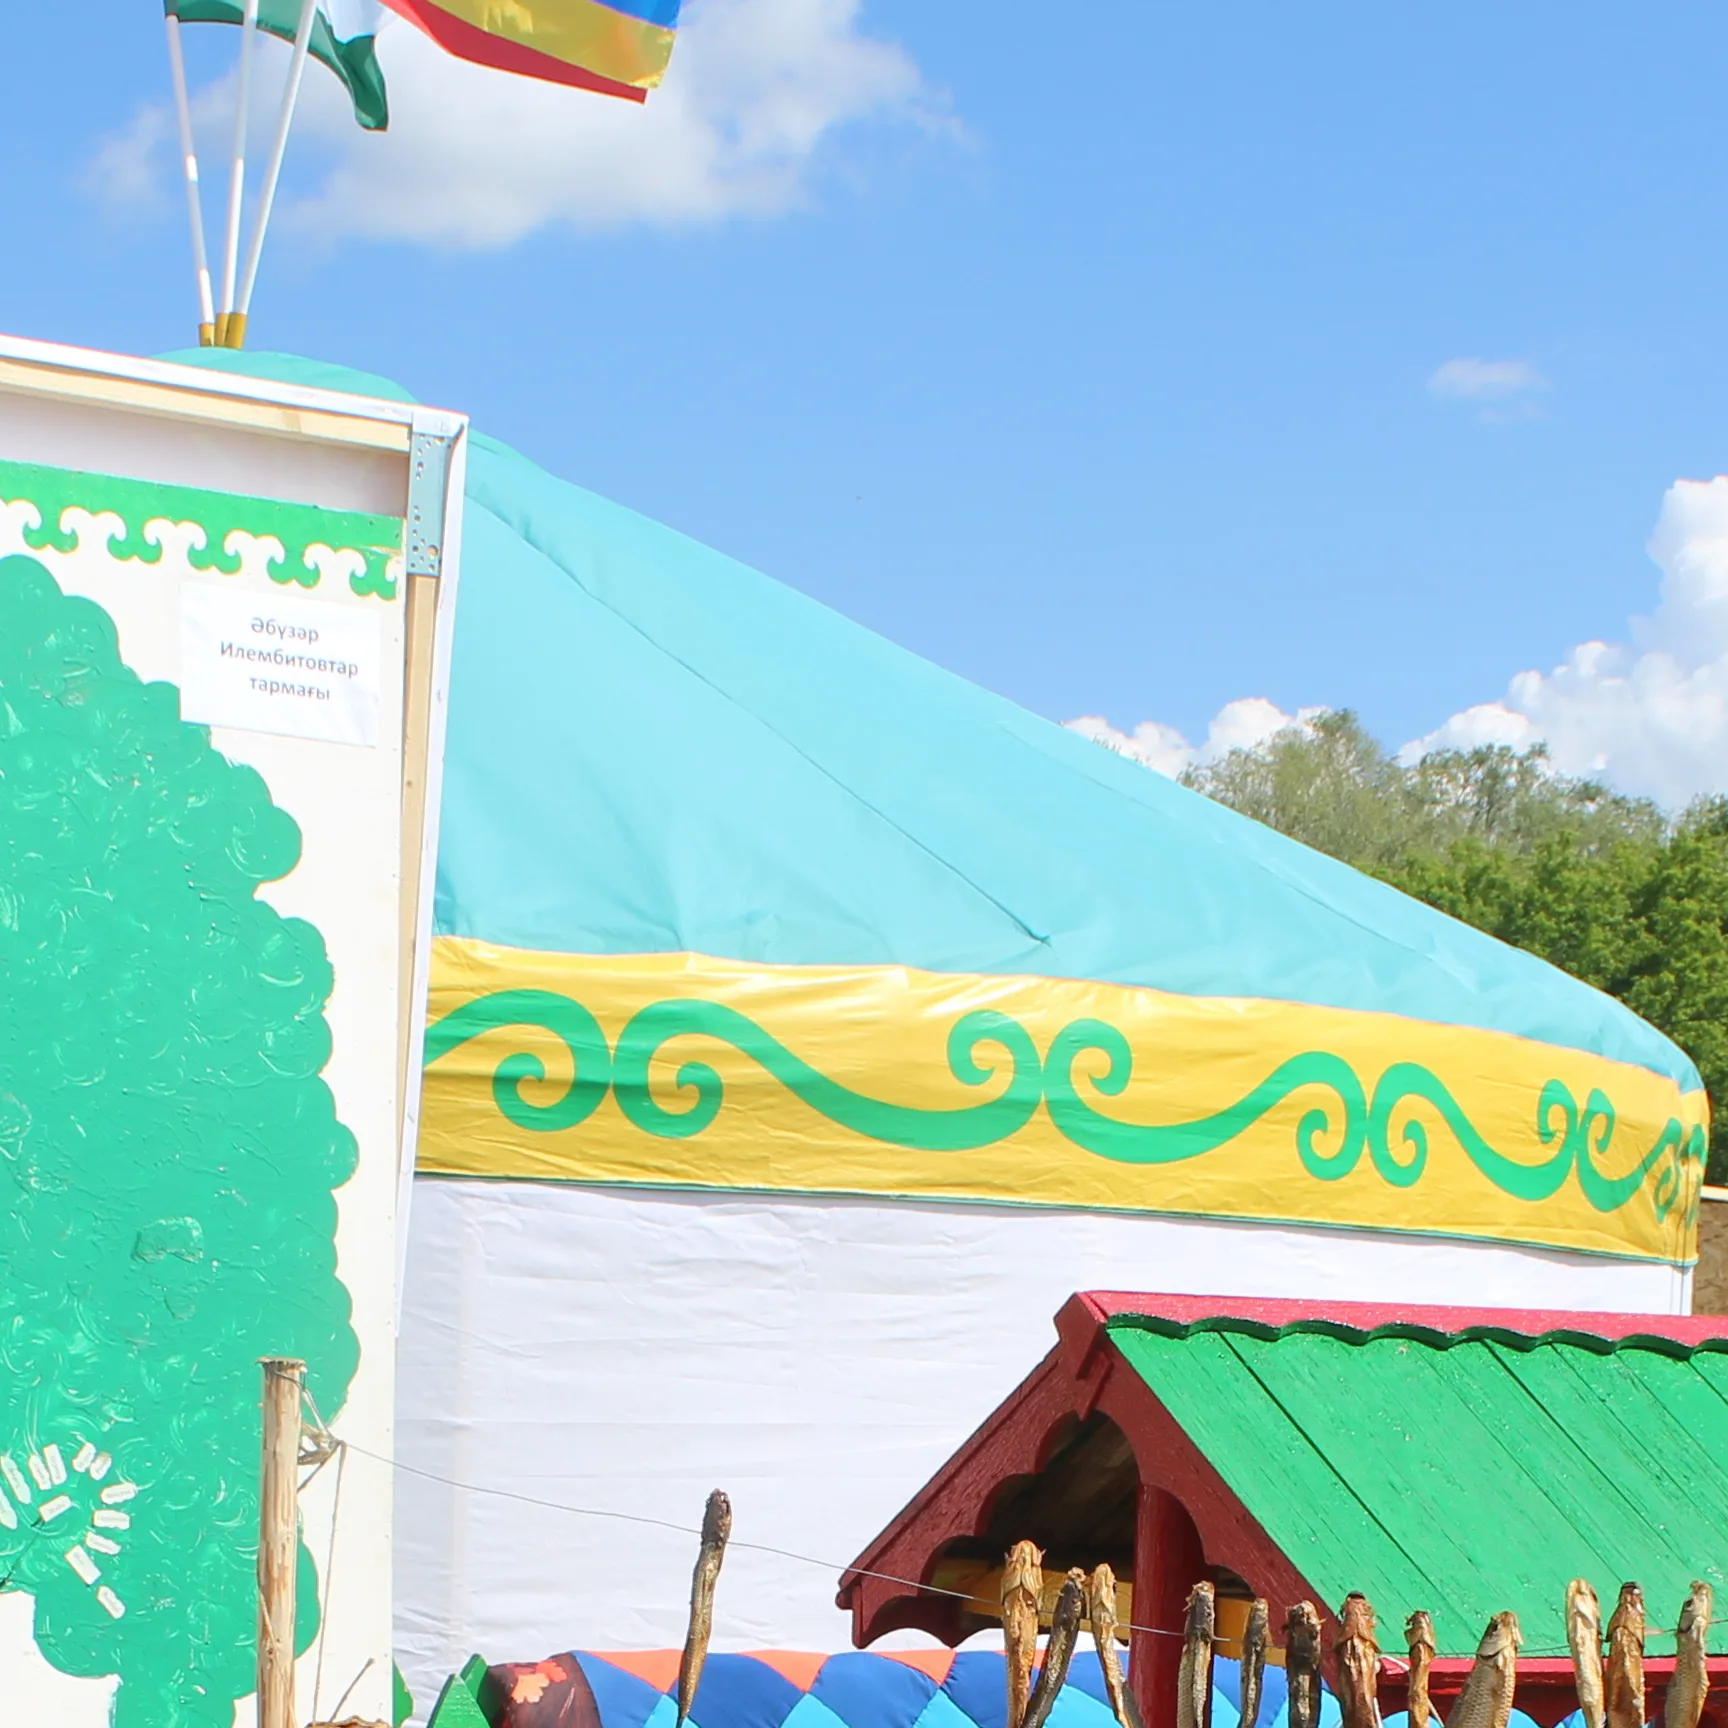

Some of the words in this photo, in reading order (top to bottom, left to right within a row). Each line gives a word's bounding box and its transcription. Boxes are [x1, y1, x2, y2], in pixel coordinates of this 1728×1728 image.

[251, 617, 319, 644] Әбүзәр
[220, 641, 359, 678] Илембитовтар
[249, 676, 330, 700] тармағы
